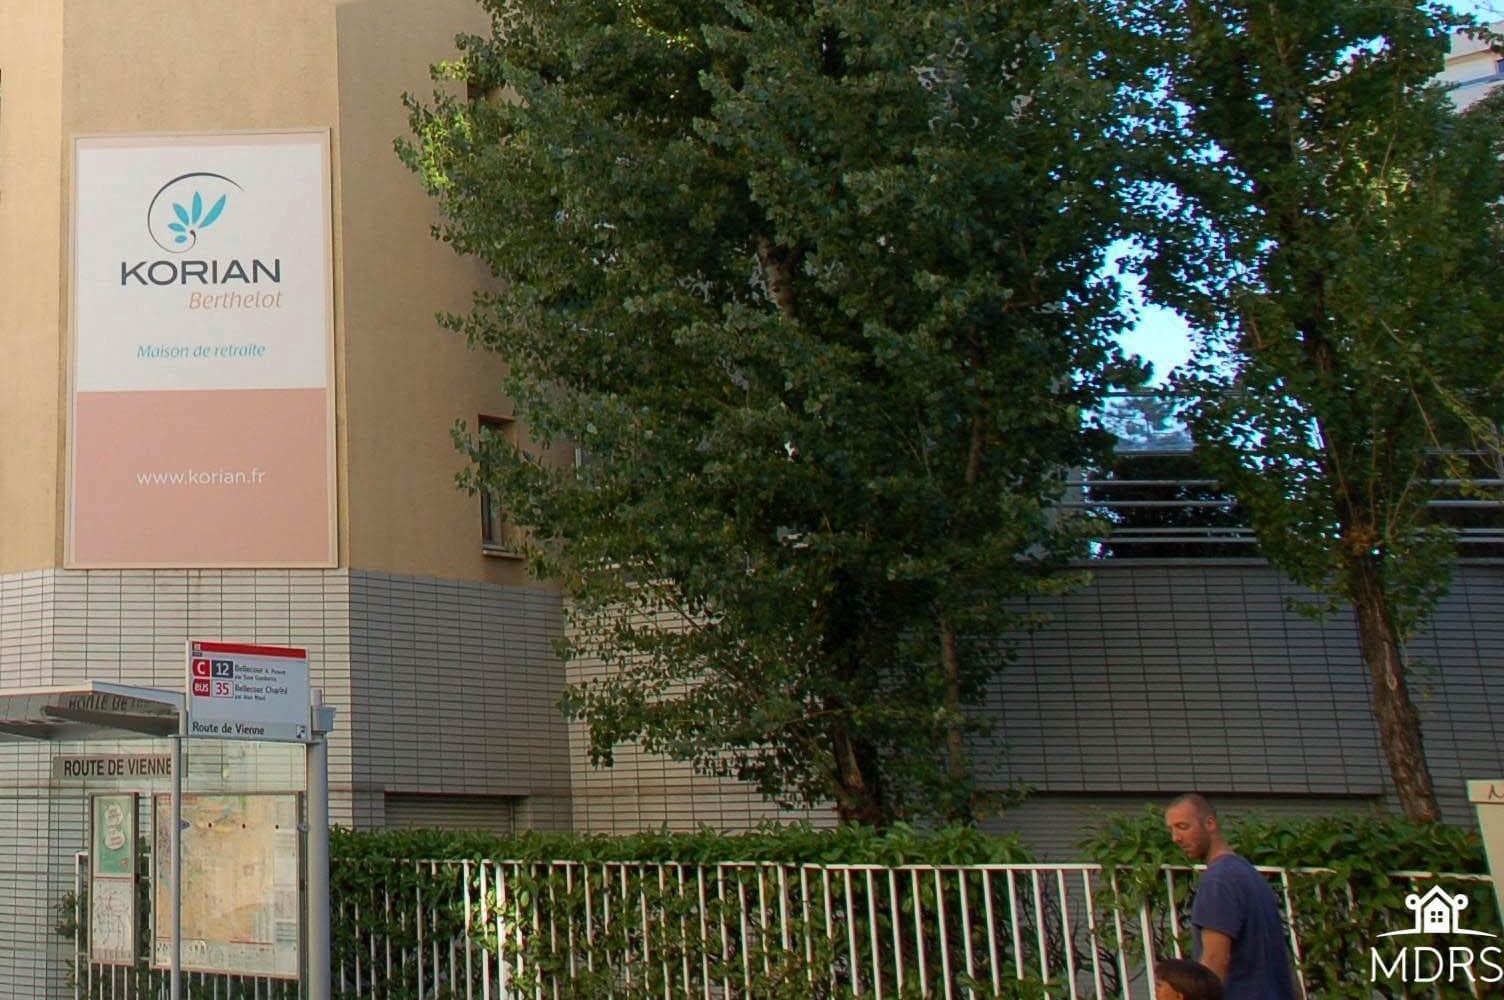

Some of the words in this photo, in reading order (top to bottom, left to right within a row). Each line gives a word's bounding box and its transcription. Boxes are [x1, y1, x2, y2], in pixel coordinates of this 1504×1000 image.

[121, 258, 281, 286] KORIAN
[189, 290, 283, 310] Berthelot
[136, 345, 189, 358] Maison
[193, 344, 211, 357] de
[214, 343, 266, 357] retraite
[136, 467, 266, 485] www.korian.fr
[196, 662, 206, 675] C
[215, 663, 230, 676] 12
[194, 685, 209, 693] BUS
[215, 682, 230, 695] 35
[192, 721, 218, 733] Route
[221, 722, 233, 734] de
[235, 723, 265, 735] Vienne
[64, 759, 105, 777] ROUTE
[108, 759, 125, 776] DE
[128, 757, 172, 775] VIENNE
